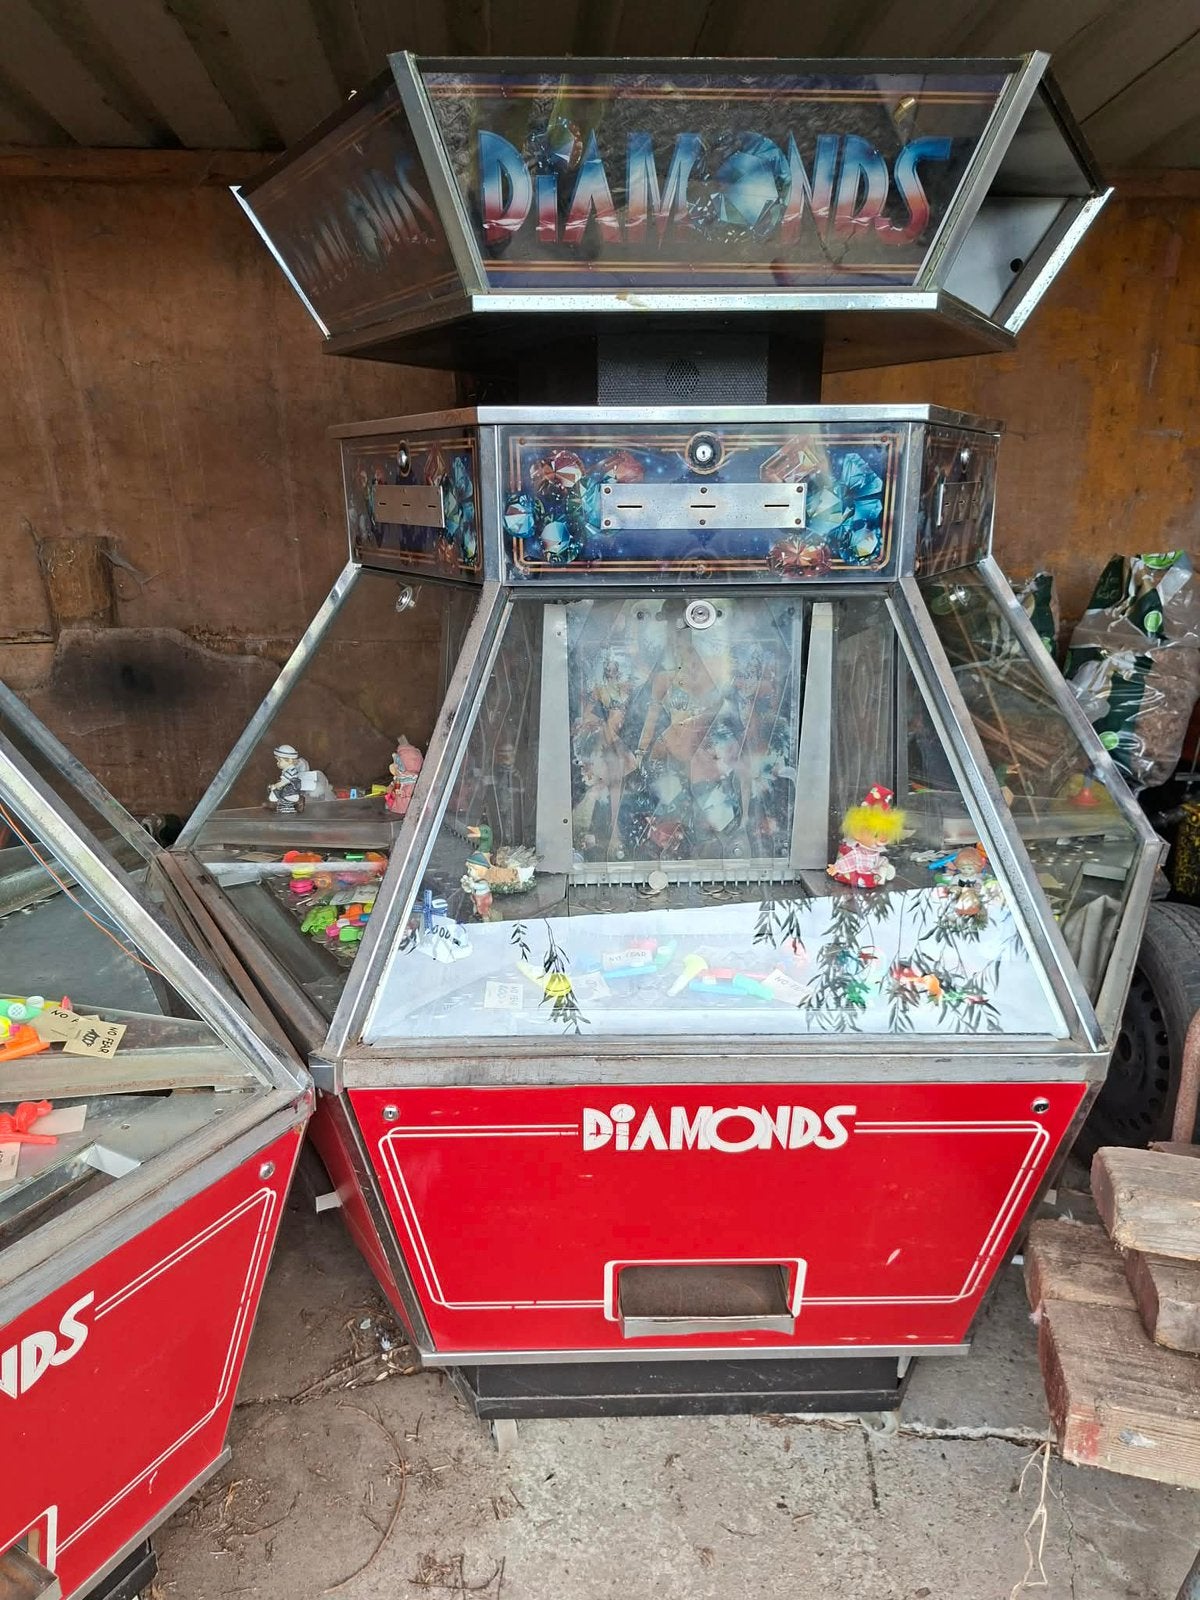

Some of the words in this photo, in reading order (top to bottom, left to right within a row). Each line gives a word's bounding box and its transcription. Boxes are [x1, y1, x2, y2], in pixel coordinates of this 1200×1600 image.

[50, 1009, 69, 1019] NO
[106, 1026, 119, 1036] NO
[98, 1037, 115, 1054] FEAR
